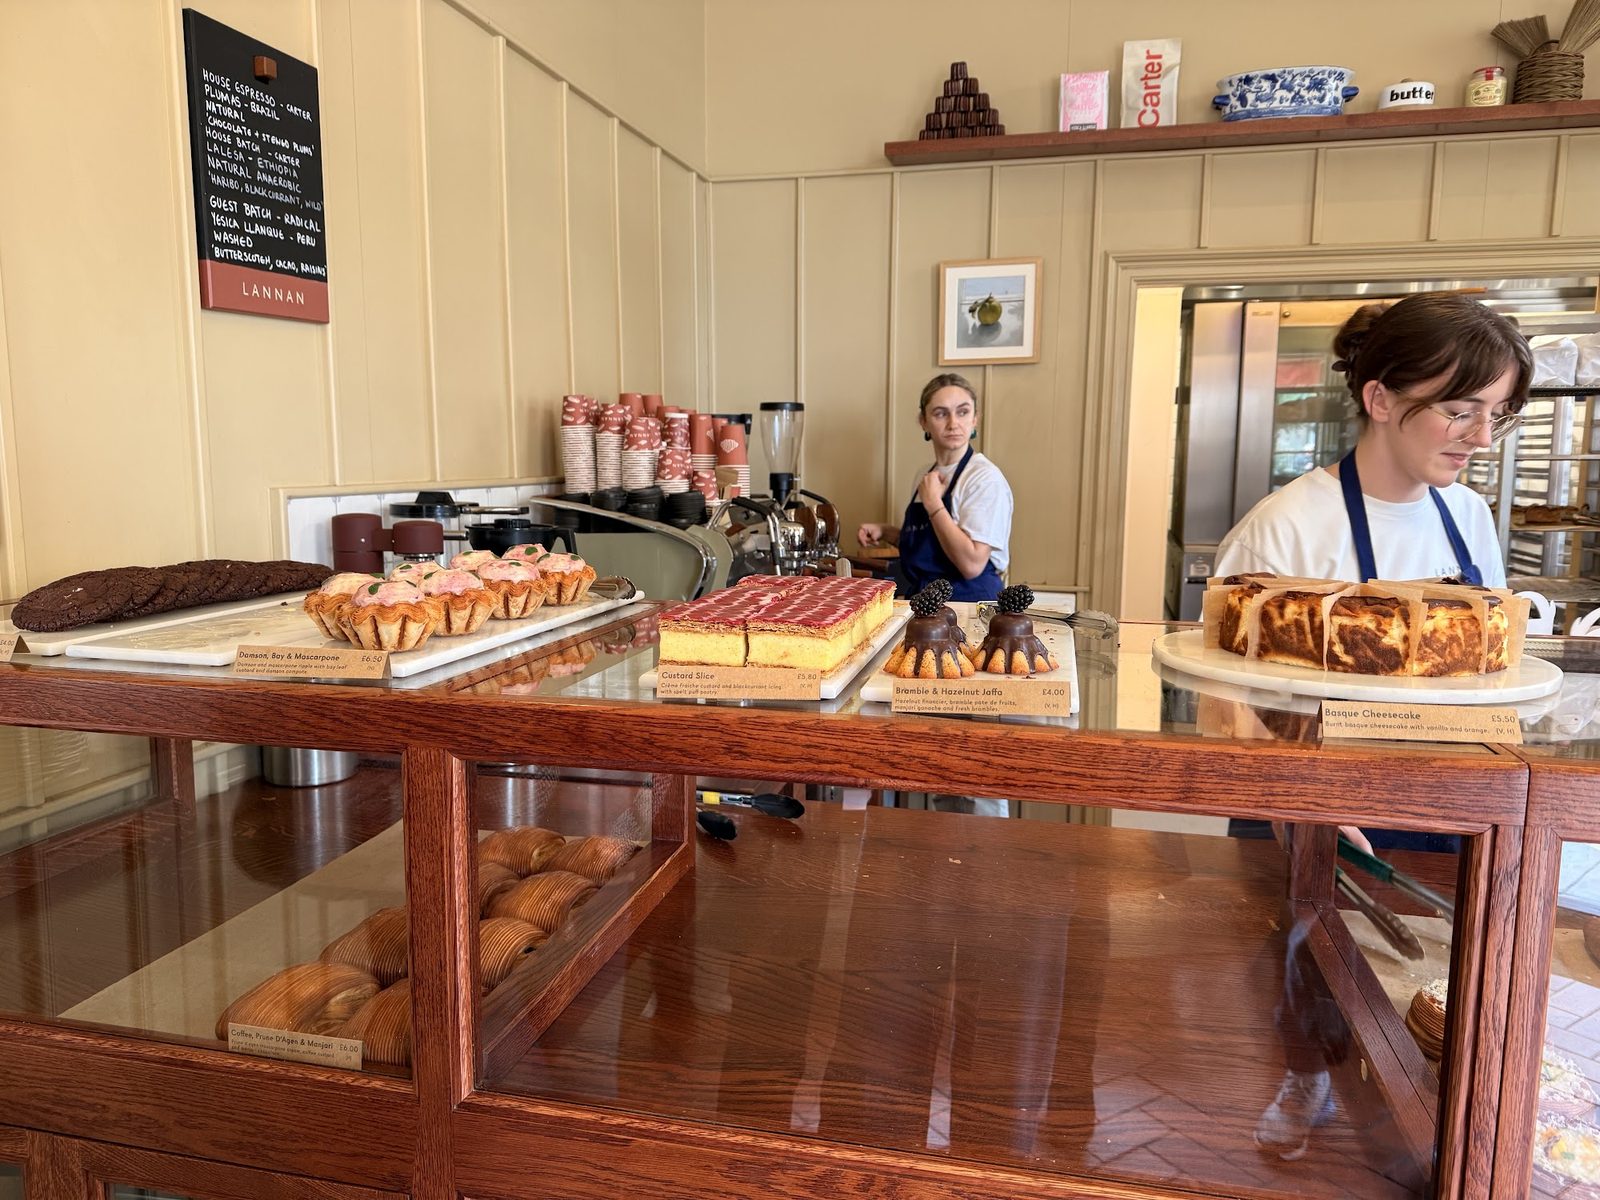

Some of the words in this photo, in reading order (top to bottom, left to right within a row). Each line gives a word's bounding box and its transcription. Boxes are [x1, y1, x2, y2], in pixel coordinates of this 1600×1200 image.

[202, 68, 231, 91] HOUSE
[235, 81, 276, 107] ESPRESSO
[286, 104, 312, 122] CARTER
[1138, 49, 1163, 128] Carter
[204, 84, 241, 108] PLUMAS
[250, 101, 280, 120] BRAZIL
[205, 100, 245, 122] NATURAL
[205, 126, 232, 145] HOUSE
[236, 136, 261, 154] BATCH
[274, 151, 301, 168] CARTER
[206, 141, 245, 163] LALESA
[257, 157, 299, 179] ETHIOPIA
[207, 154, 252, 179] NATURAL
[256, 170, 302, 193] ANAEROBIC
[209, 195, 238, 213] GUEST
[243, 202, 272, 220] BATCH
[284, 213, 321, 232] RADICAL
[211, 212, 240, 229] YESICA
[244, 221, 285, 240] LLANQUE
[296, 232, 316, 247] PERU
[213, 230, 253, 248] WASHED
[242, 281, 305, 305] LANNAN
[239, 651, 269, 660] Damson,
[271, 652, 285, 661] Bay
[286, 652, 292, 660] &
[294, 652, 340, 662] Mascarpone
[361, 655, 383, 663] £6.50
[661, 671, 694, 680] Custard
[695, 671, 715, 680] Slice
[895, 686, 930, 695] Bramble
[931, 687, 939, 695] &
[941, 687, 980, 696] Hazelnut
[981, 687, 1003, 696] Jaffa
[1042, 688, 1065, 696] £4.00
[1325, 708, 1359, 718] Basque
[1362, 709, 1421, 720] Cheesecake
[1491, 714, 1516, 723] £5.50
[1344, 721, 1368, 729] basque
[1369, 722, 1408, 730] cheesecake
[231, 1029, 254, 1040] Coffee,
[255, 1032, 274, 1040] Prune
[275, 1035, 299, 1045] D'Agen
[300, 1038, 305, 1046] &
[307, 1039, 334, 1050] Manjari
[339, 1043, 359, 1053] £6.00
